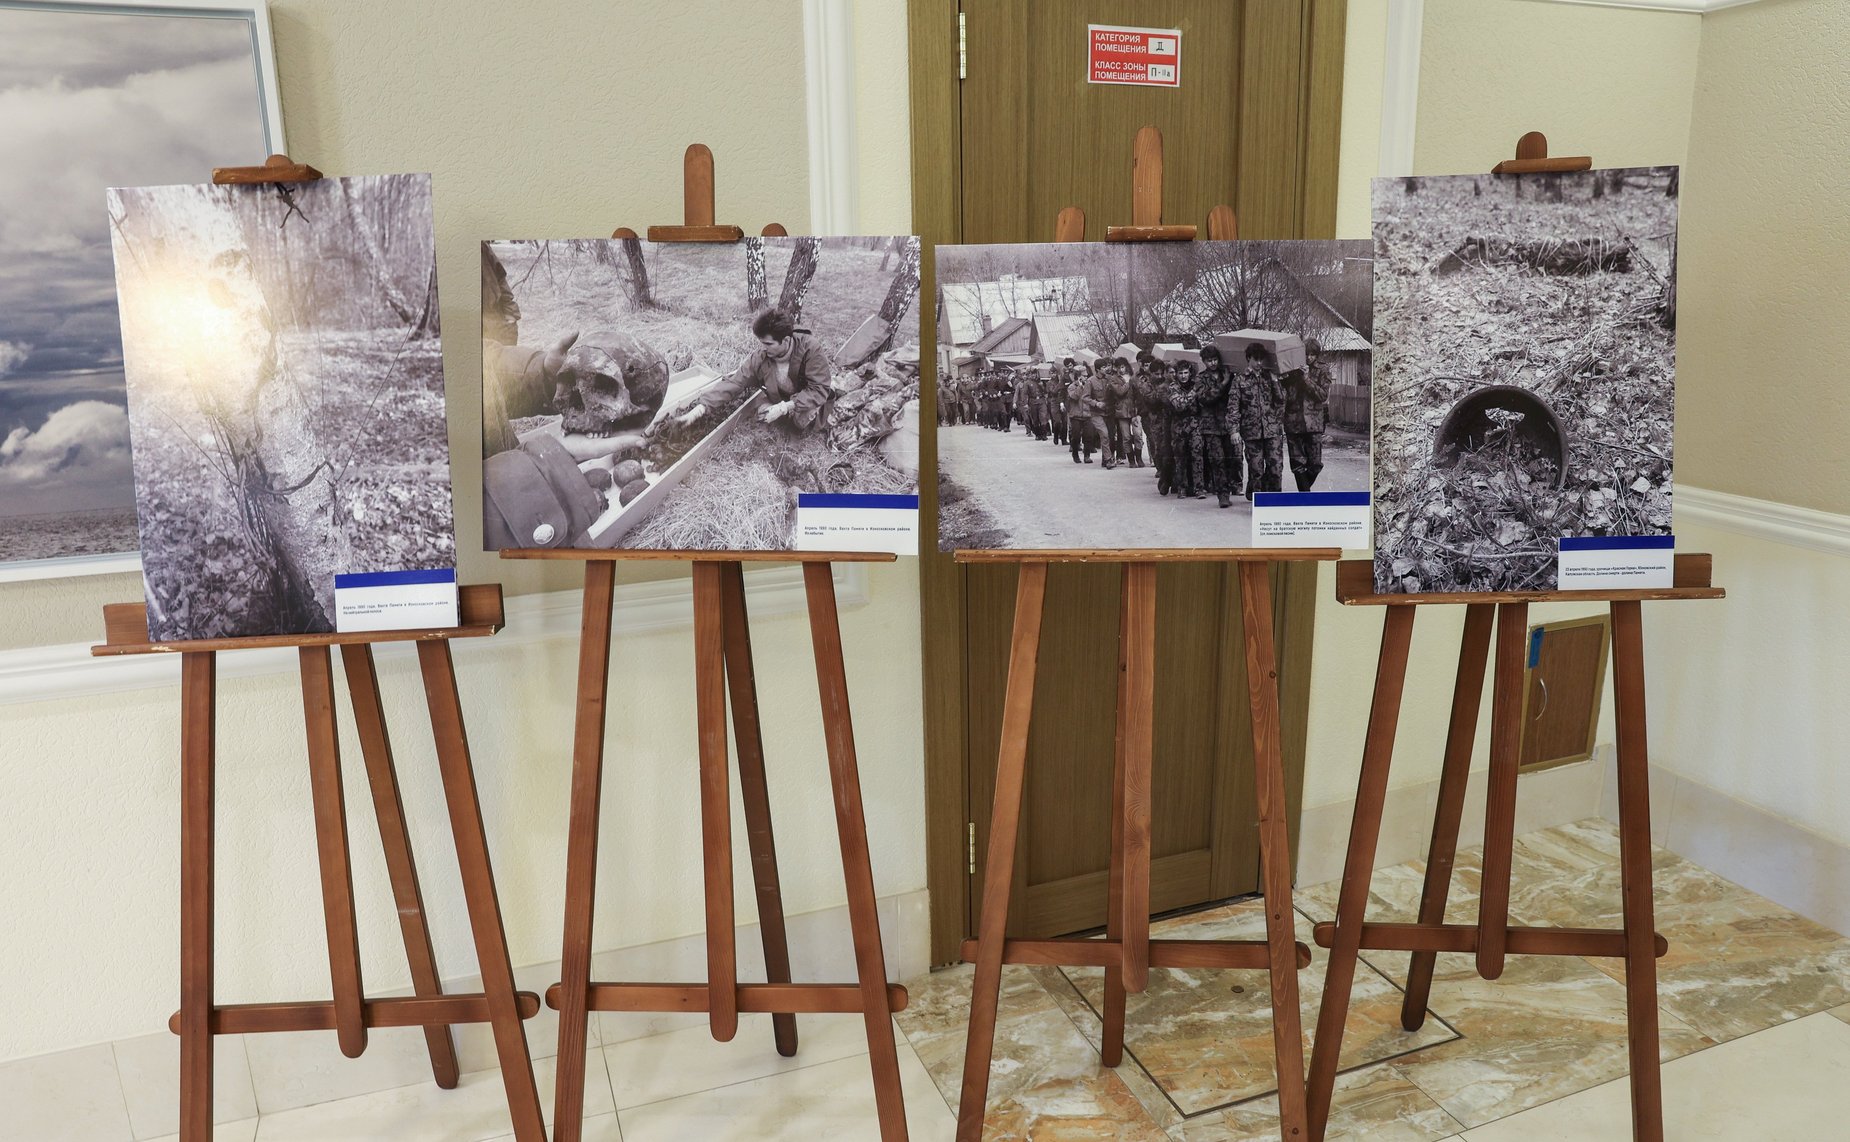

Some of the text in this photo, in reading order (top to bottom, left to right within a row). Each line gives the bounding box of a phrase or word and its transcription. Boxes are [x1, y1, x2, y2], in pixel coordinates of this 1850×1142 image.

[1095, 32, 1140, 43] КАТЕГОРИЯ
[1095, 44, 1146, 54] ПОМЕЩЕНИЯ
[1156, 42, 1164, 52] Д
[1095, 61, 1146, 71] КЛАСС ЗОНЫ
[1095, 71, 1146, 81] ПОМЕЩЕНИЯ
